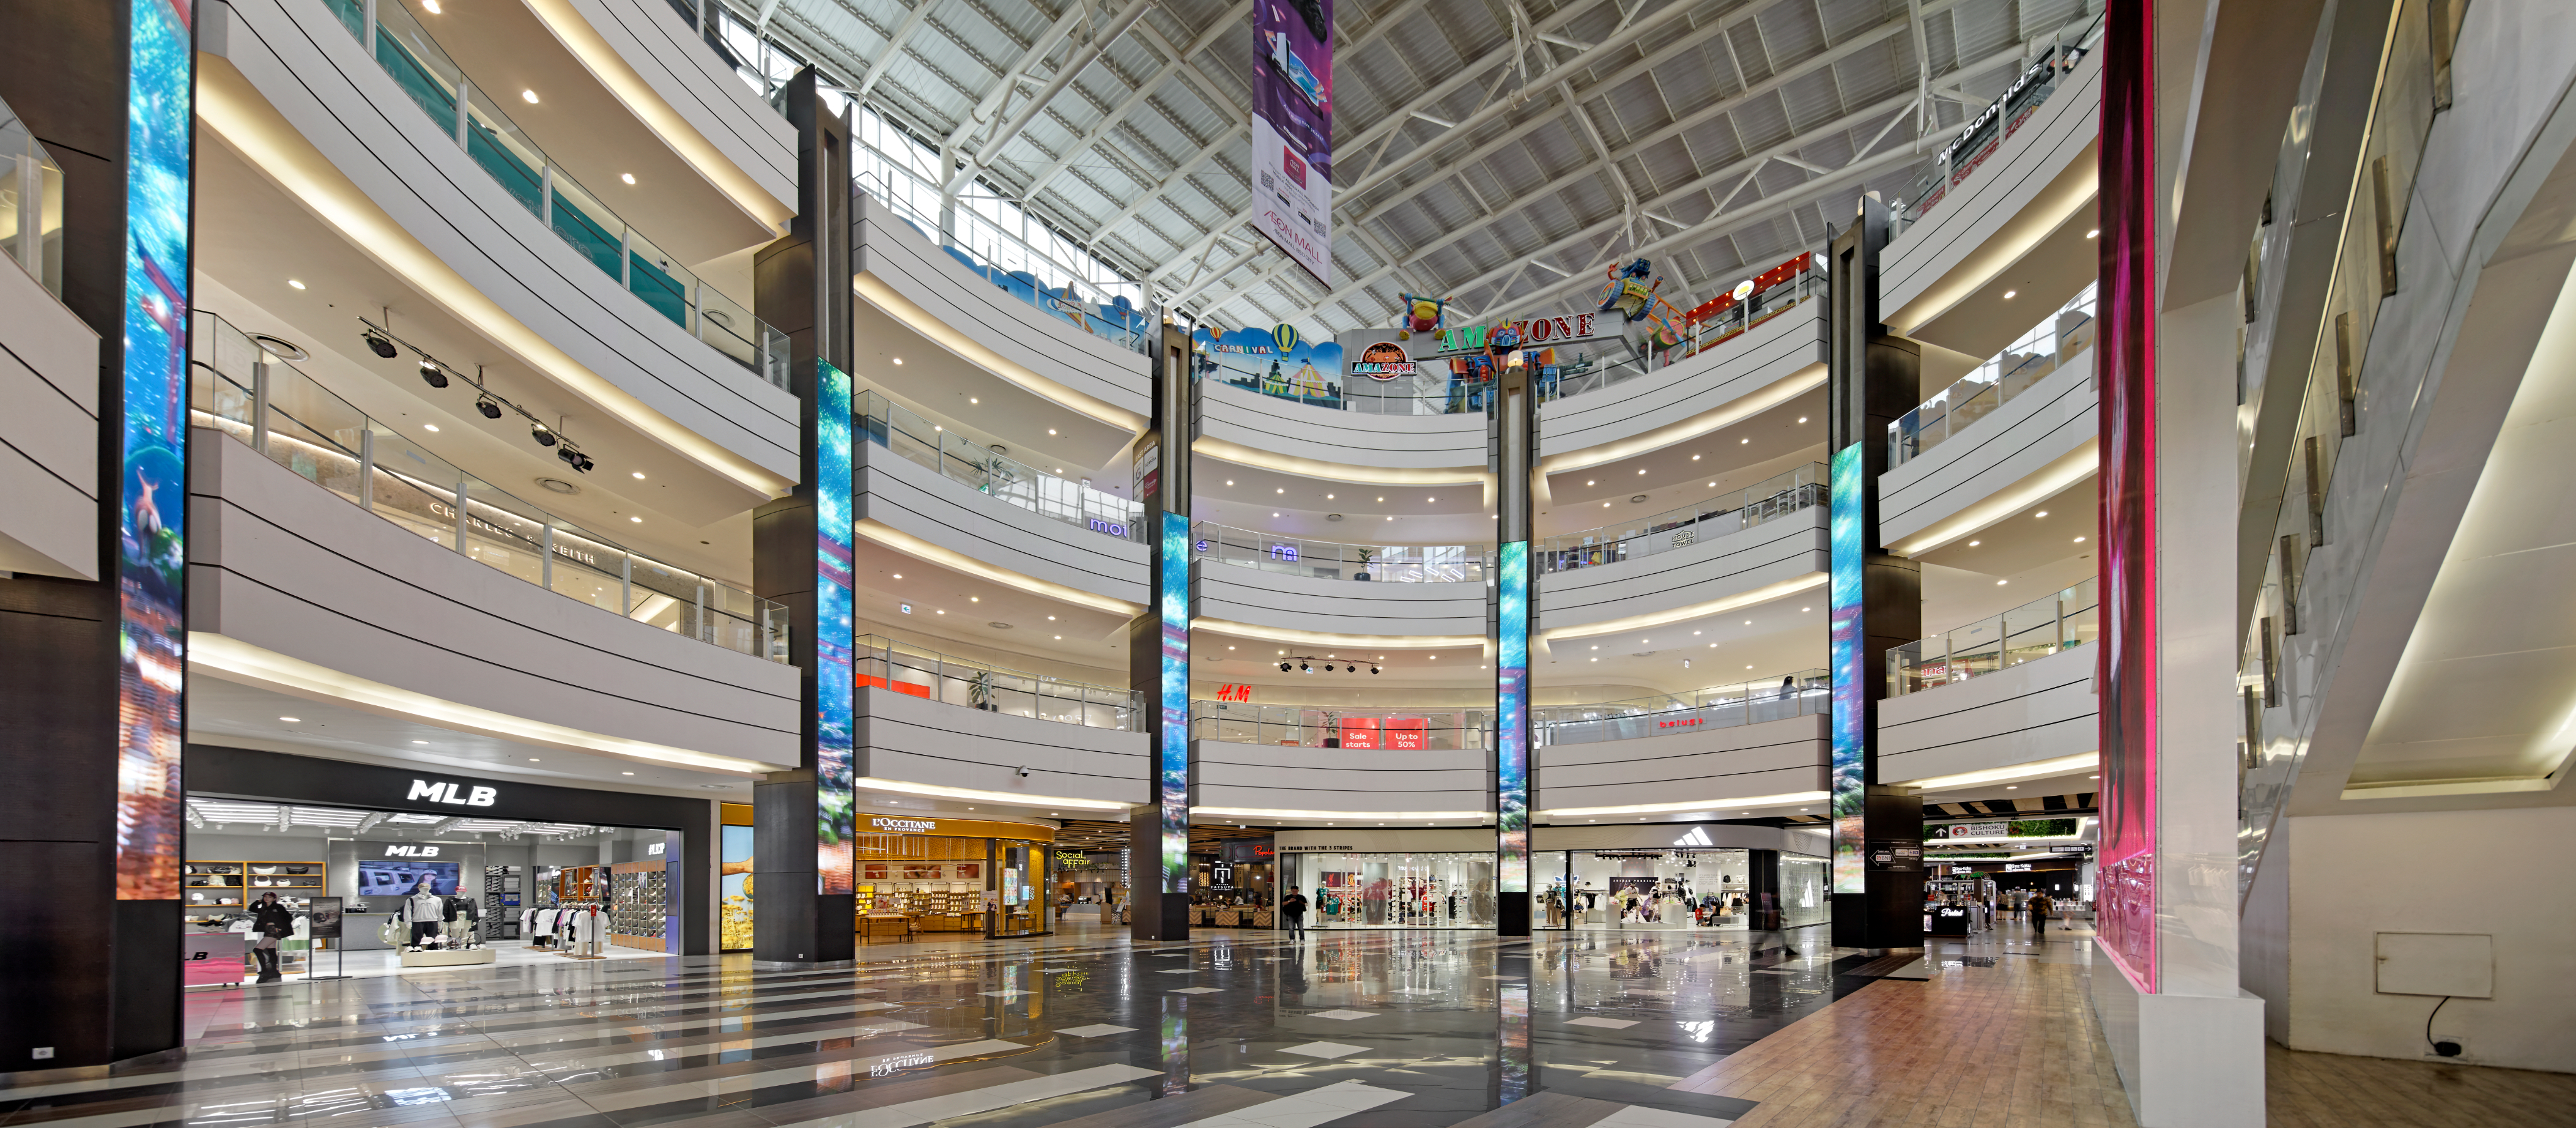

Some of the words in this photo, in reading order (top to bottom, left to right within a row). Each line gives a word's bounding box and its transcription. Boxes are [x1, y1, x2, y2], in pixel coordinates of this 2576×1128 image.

[1284, 238, 1296, 250] MALL
[1296, 248, 1305, 257] BSD
[1305, 255, 1314, 265] CITY
[1295, 233, 1323, 264] MALL
[1214, 345, 1274, 354] CARNIVAL
[1353, 363, 1415, 373] AMAZONE
[1135, 450, 1143, 462] EAST
[1143, 440, 1155, 453] AREA
[1672, 532, 1695, 541] HOUSE
[1672, 539, 1695, 548] TOWEL
[552, 544, 596, 565] KEITH
[407, 779, 497, 807] MLB
[872, 818, 936, 829] L'OCCITANE
[385, 846, 440, 857] MLB
